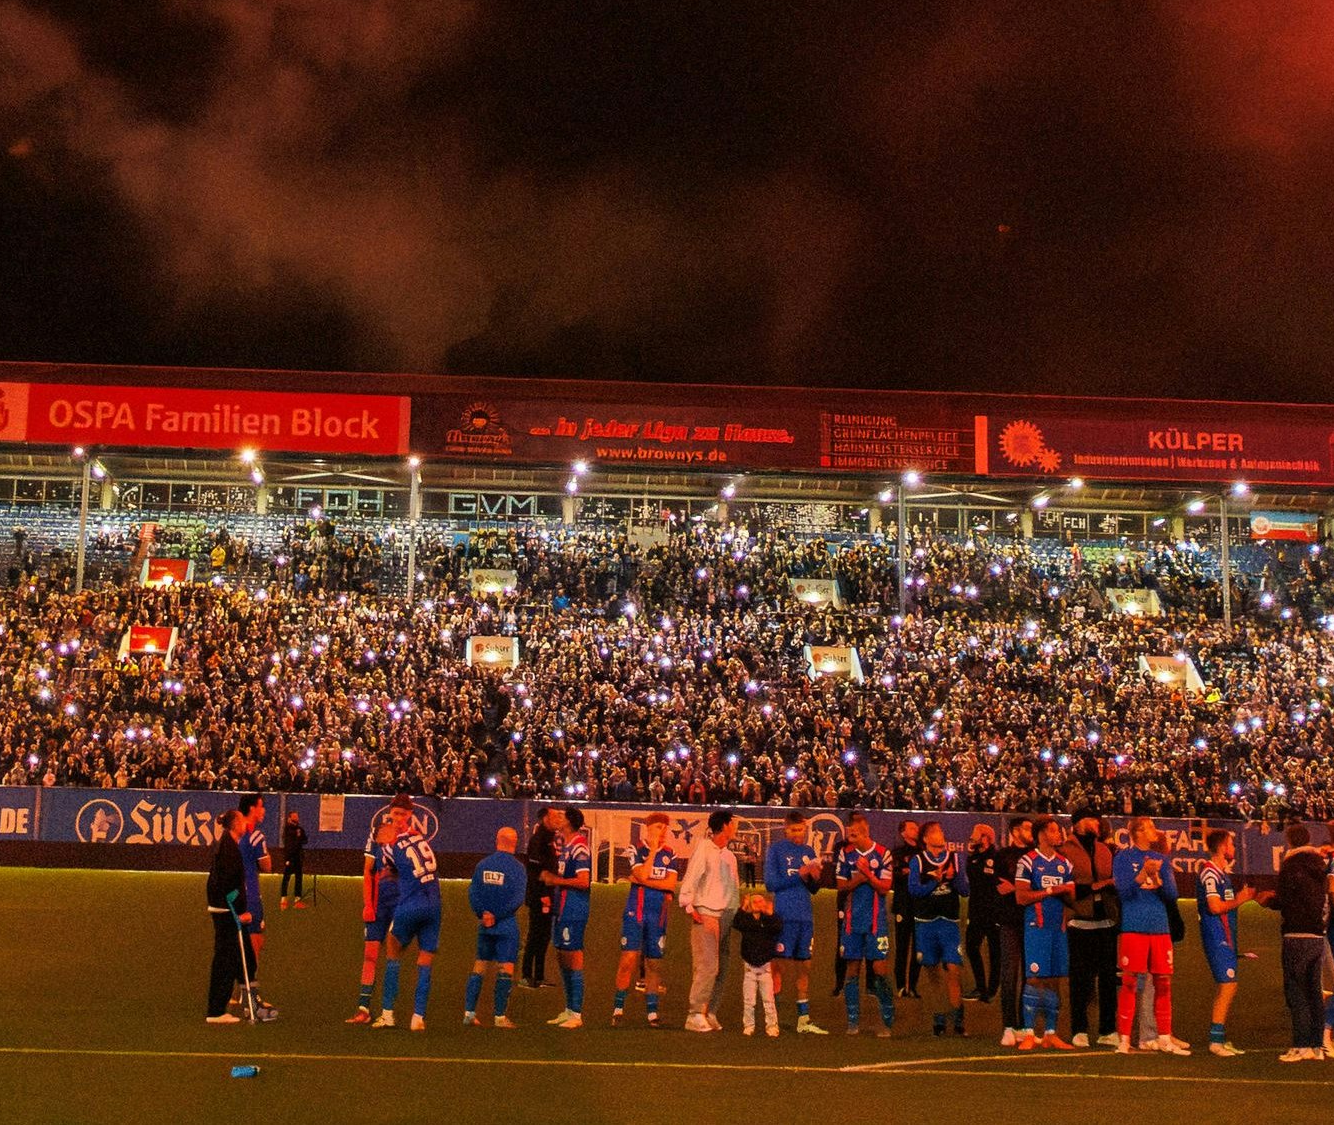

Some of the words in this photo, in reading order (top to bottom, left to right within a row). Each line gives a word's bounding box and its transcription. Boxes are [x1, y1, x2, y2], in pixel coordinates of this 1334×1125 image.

[49, 400, 135, 430] OSPA
[146, 404, 280, 435] Familien
[291, 409, 380, 440] Block
[595, 446, 727, 463] www.brownys.de
[1148, 427, 1244, 452] KÜLPER
[126, 795, 225, 846] Lübz
[406, 841, 437, 878] 19
[1042, 876, 1062, 886] SLT
